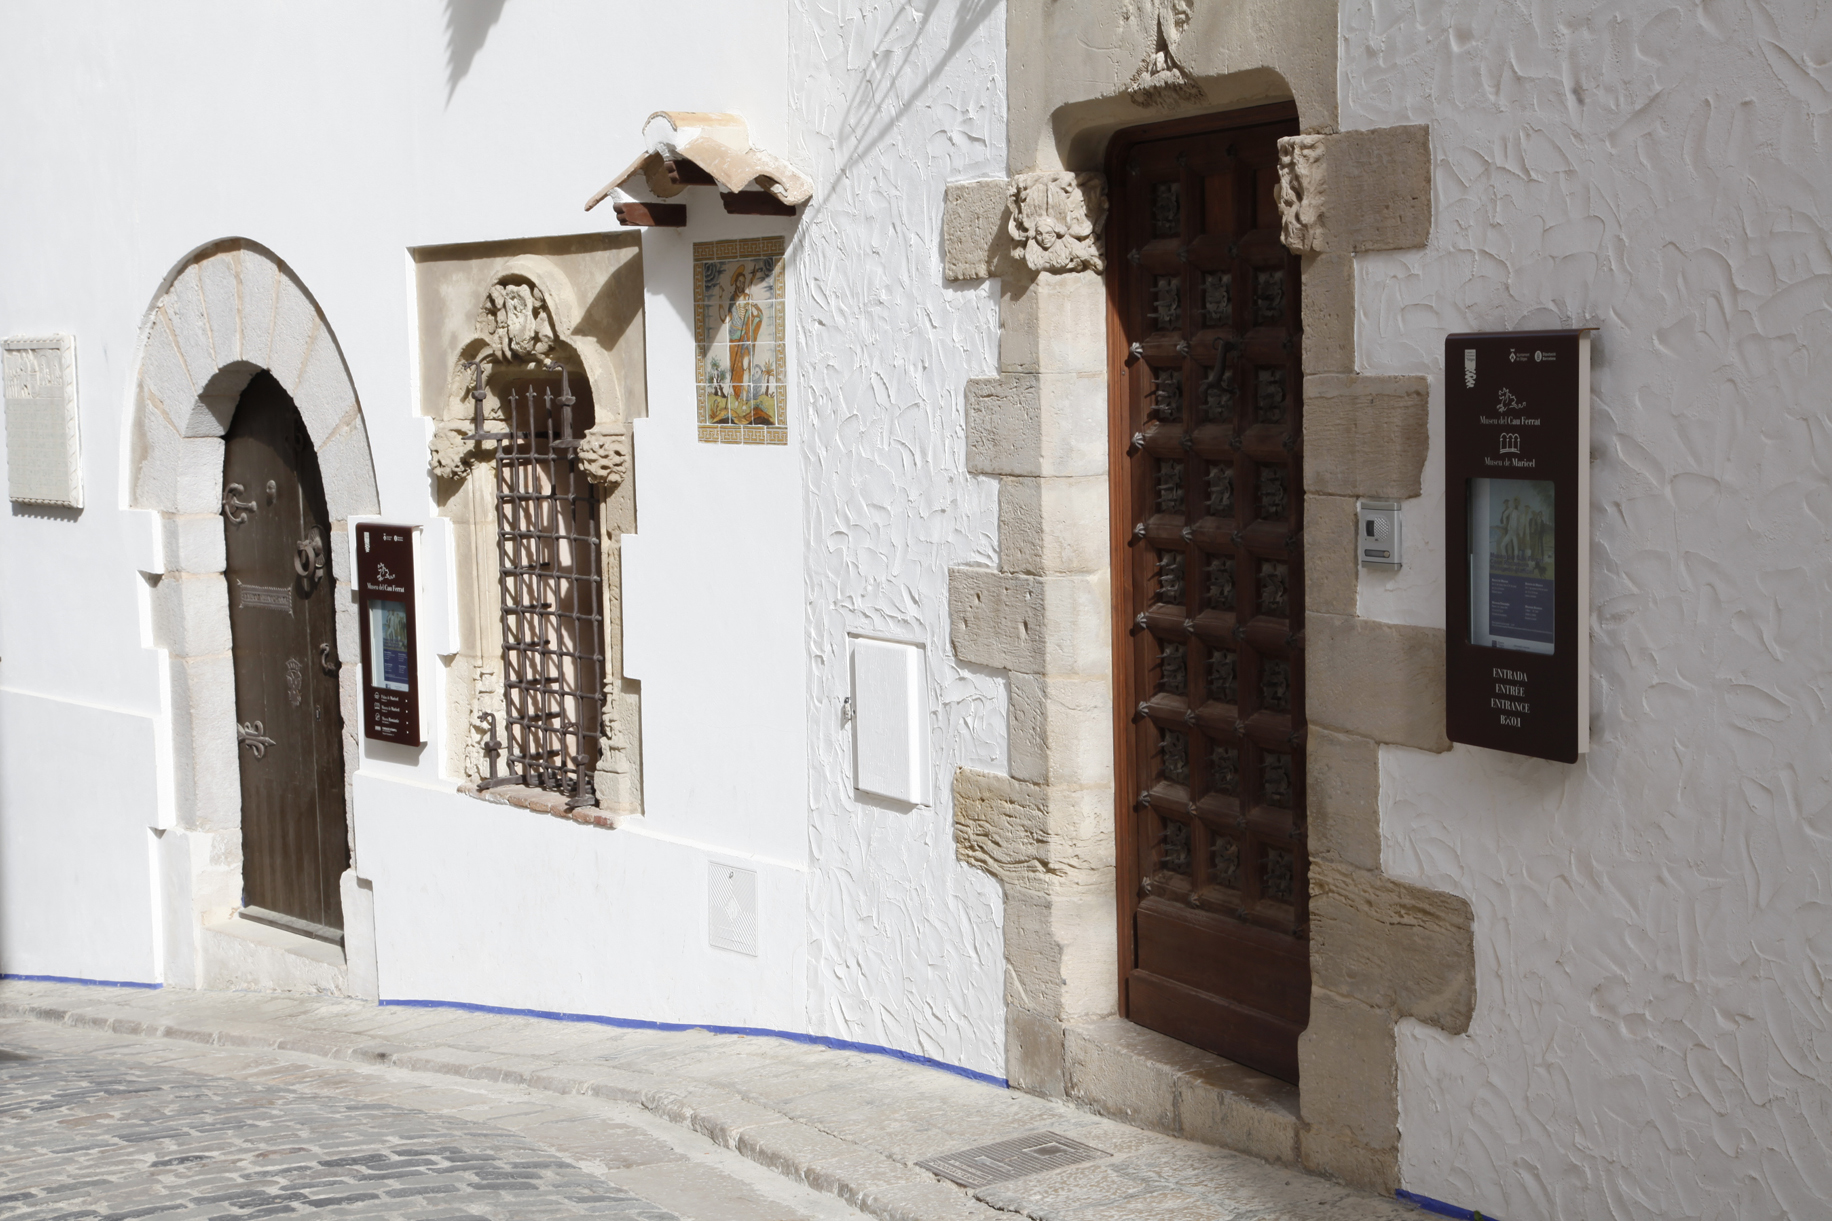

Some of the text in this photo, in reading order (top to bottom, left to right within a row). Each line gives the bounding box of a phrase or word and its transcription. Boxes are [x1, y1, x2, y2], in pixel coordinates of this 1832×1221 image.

[1480, 415, 1541, 425] Museu del Cau Ferrat
[1484, 457, 1535, 467] Museu de Maricel
[1493, 668, 1528, 682] ENTRADA
[1495, 683, 1525, 697] ENTRÉE
[1491, 698, 1530, 713] ENTRANCE
